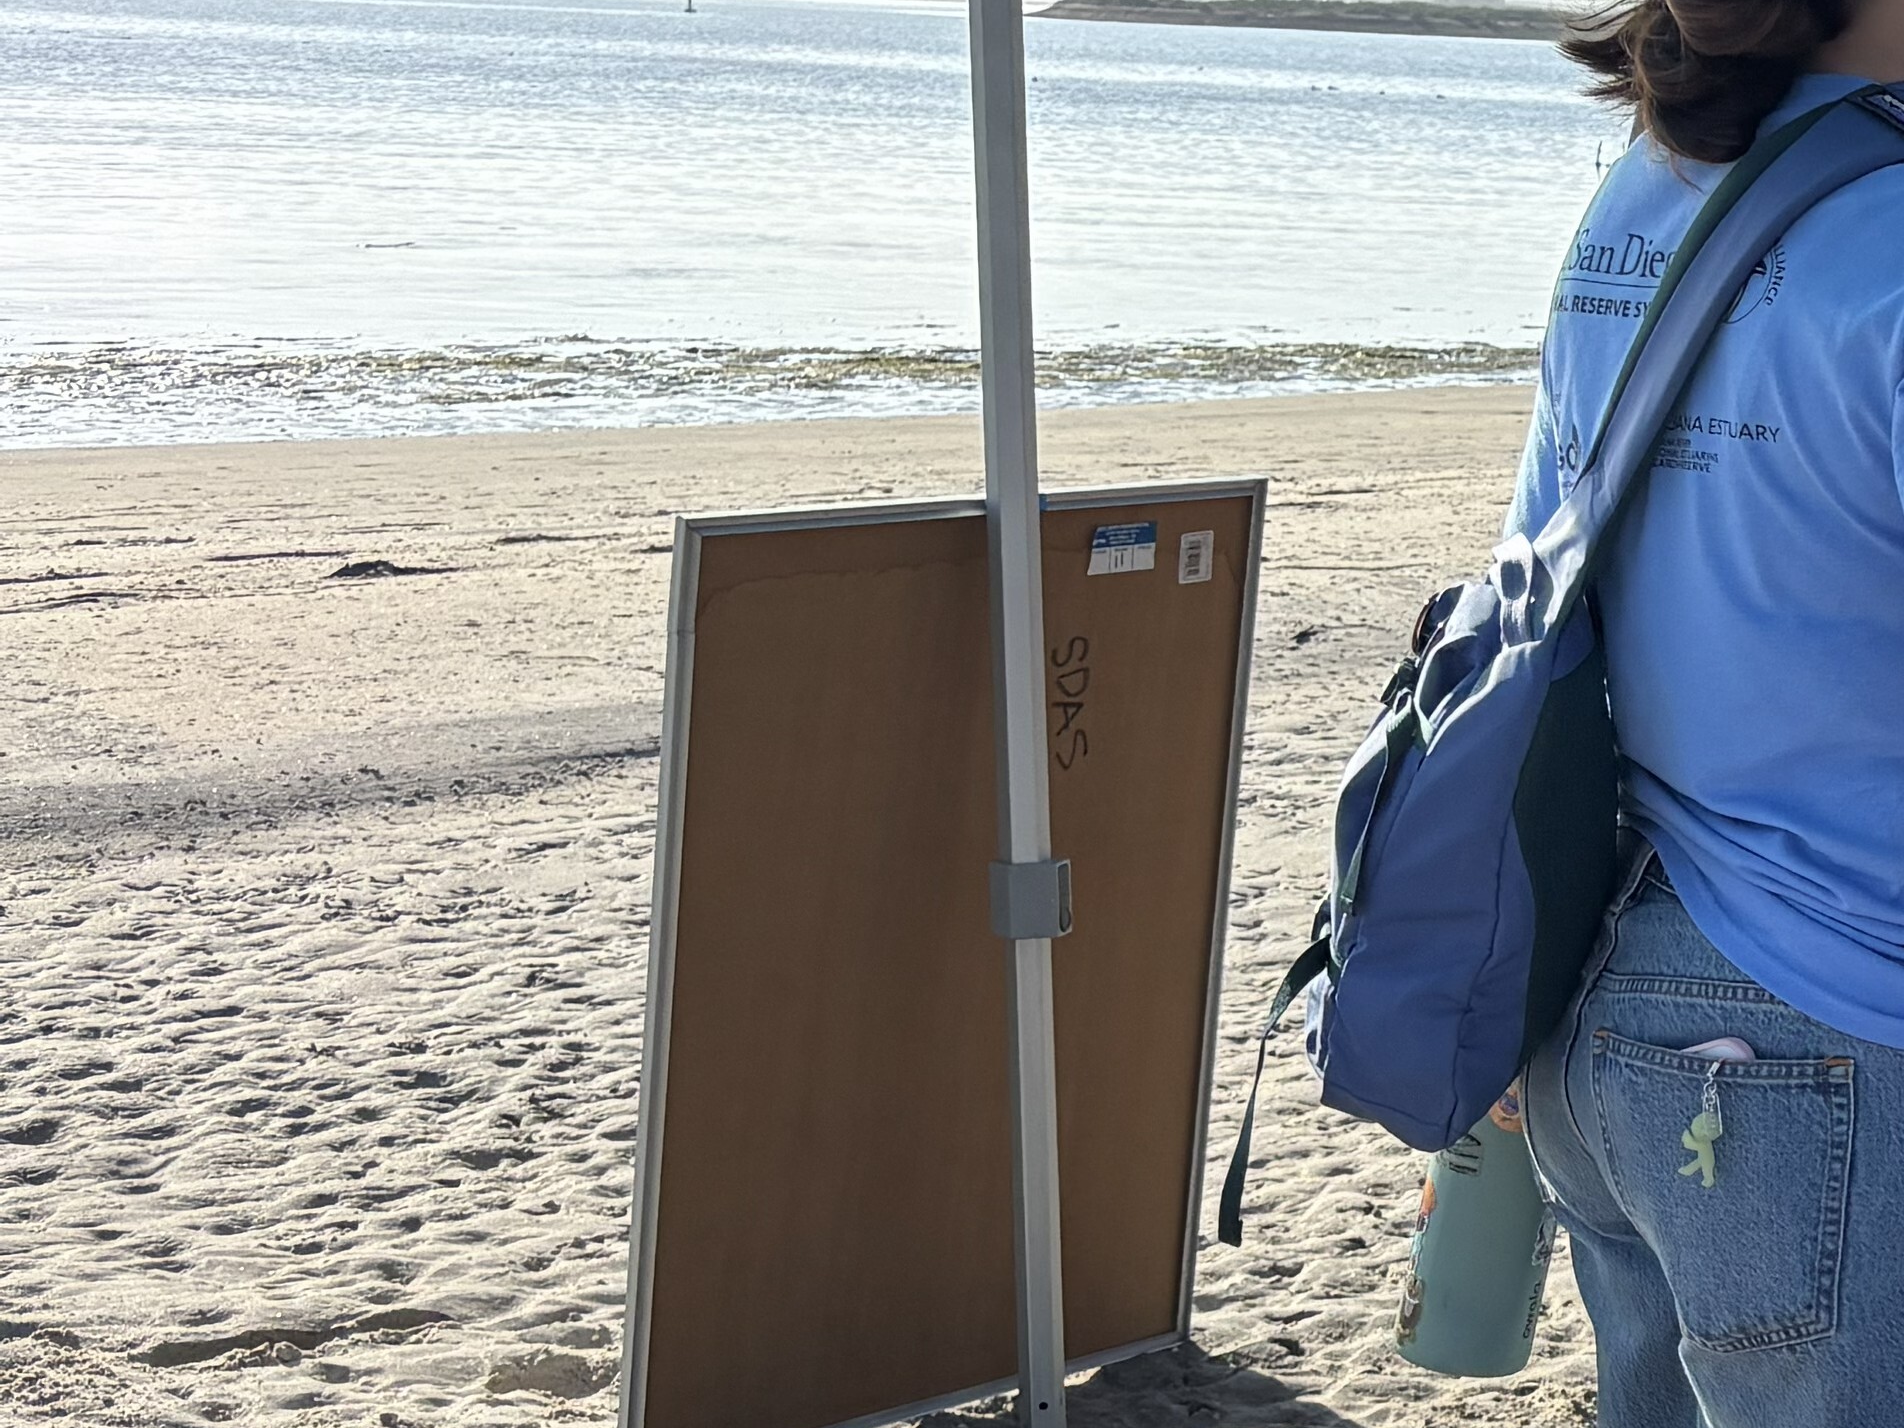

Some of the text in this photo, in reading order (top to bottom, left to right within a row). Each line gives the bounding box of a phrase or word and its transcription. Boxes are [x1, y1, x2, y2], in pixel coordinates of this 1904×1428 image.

[1572, 295, 1628, 318] RESERVE
[1709, 418, 1780, 443] ESTUARY
[1051, 635, 1092, 771] SDAS
